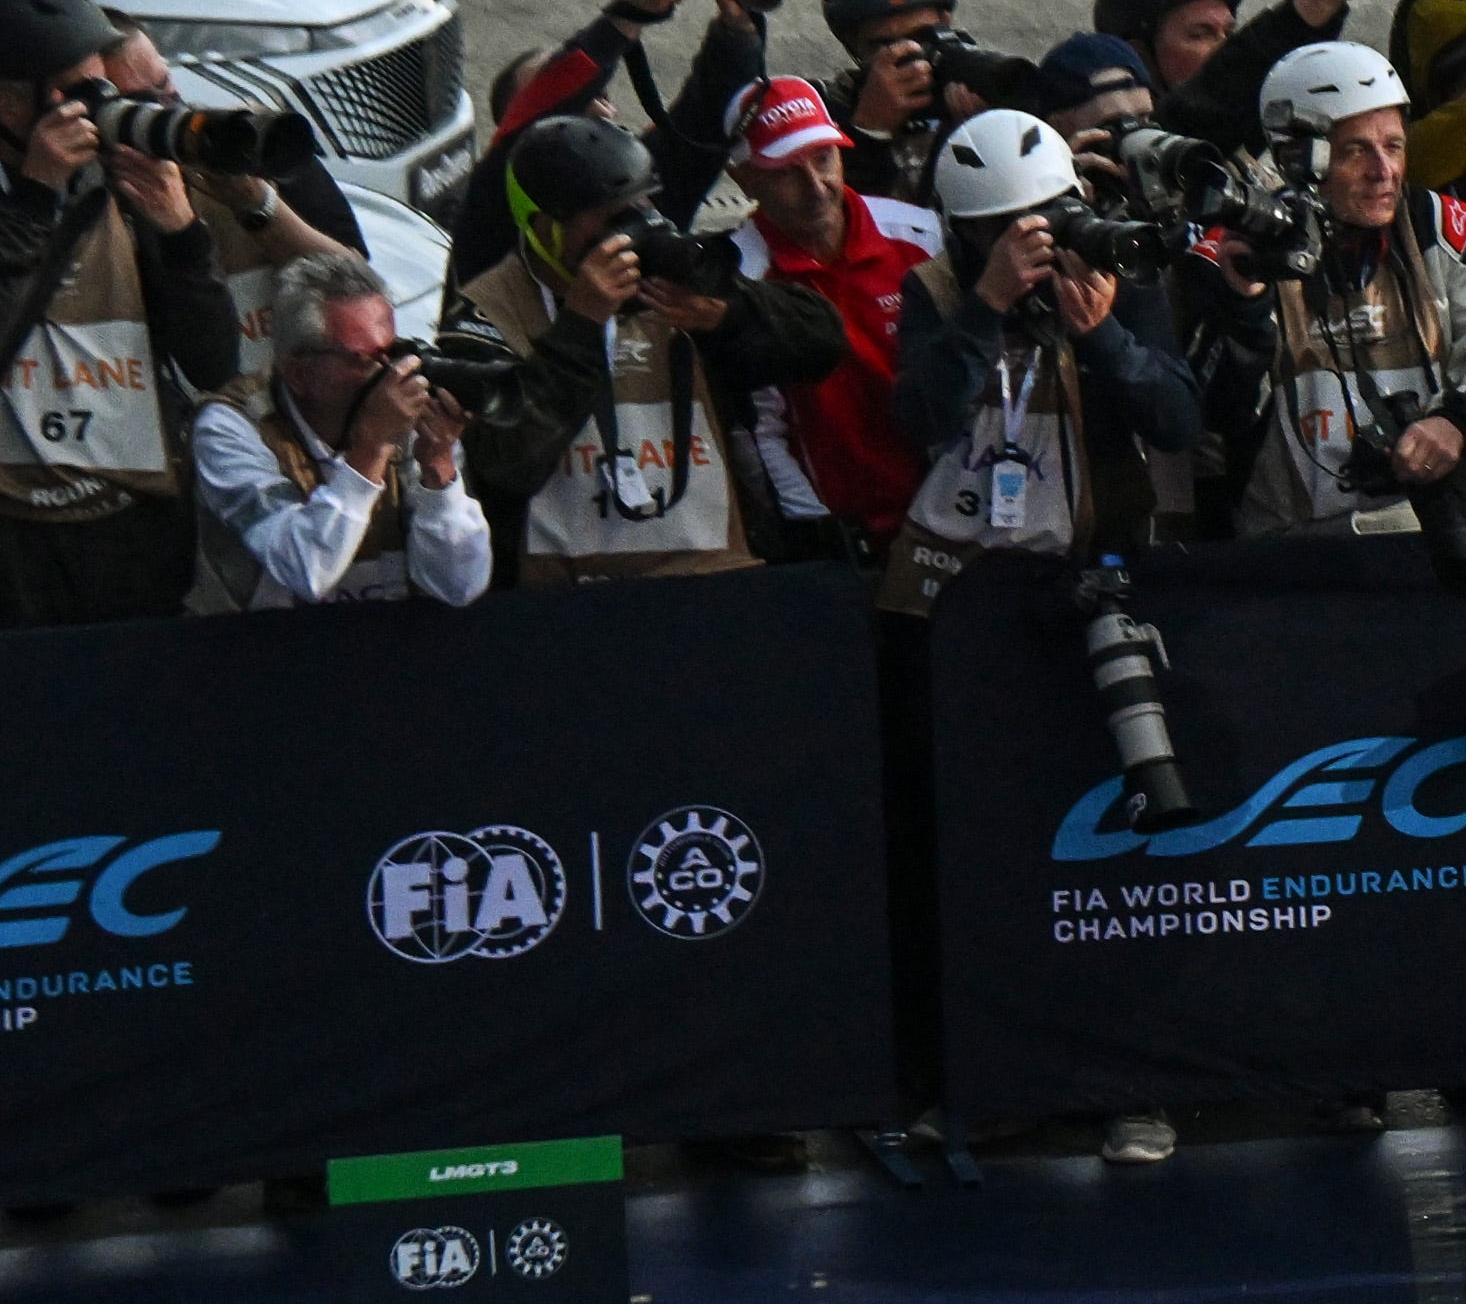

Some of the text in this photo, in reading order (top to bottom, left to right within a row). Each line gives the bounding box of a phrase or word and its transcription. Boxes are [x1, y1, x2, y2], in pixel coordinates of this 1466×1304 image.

[53, 359, 147, 390] LANE
[41, 410, 92, 443] 67
[0, 829, 223, 948] EC
[1052, 887, 1109, 914] FIA
[1121, 878, 1251, 909] WORLD
[1053, 904, 1332, 944] CHAMPIONSHIP
[0, 960, 194, 1003] NDURANCE
[428, 1159, 519, 1182] LMGT3
